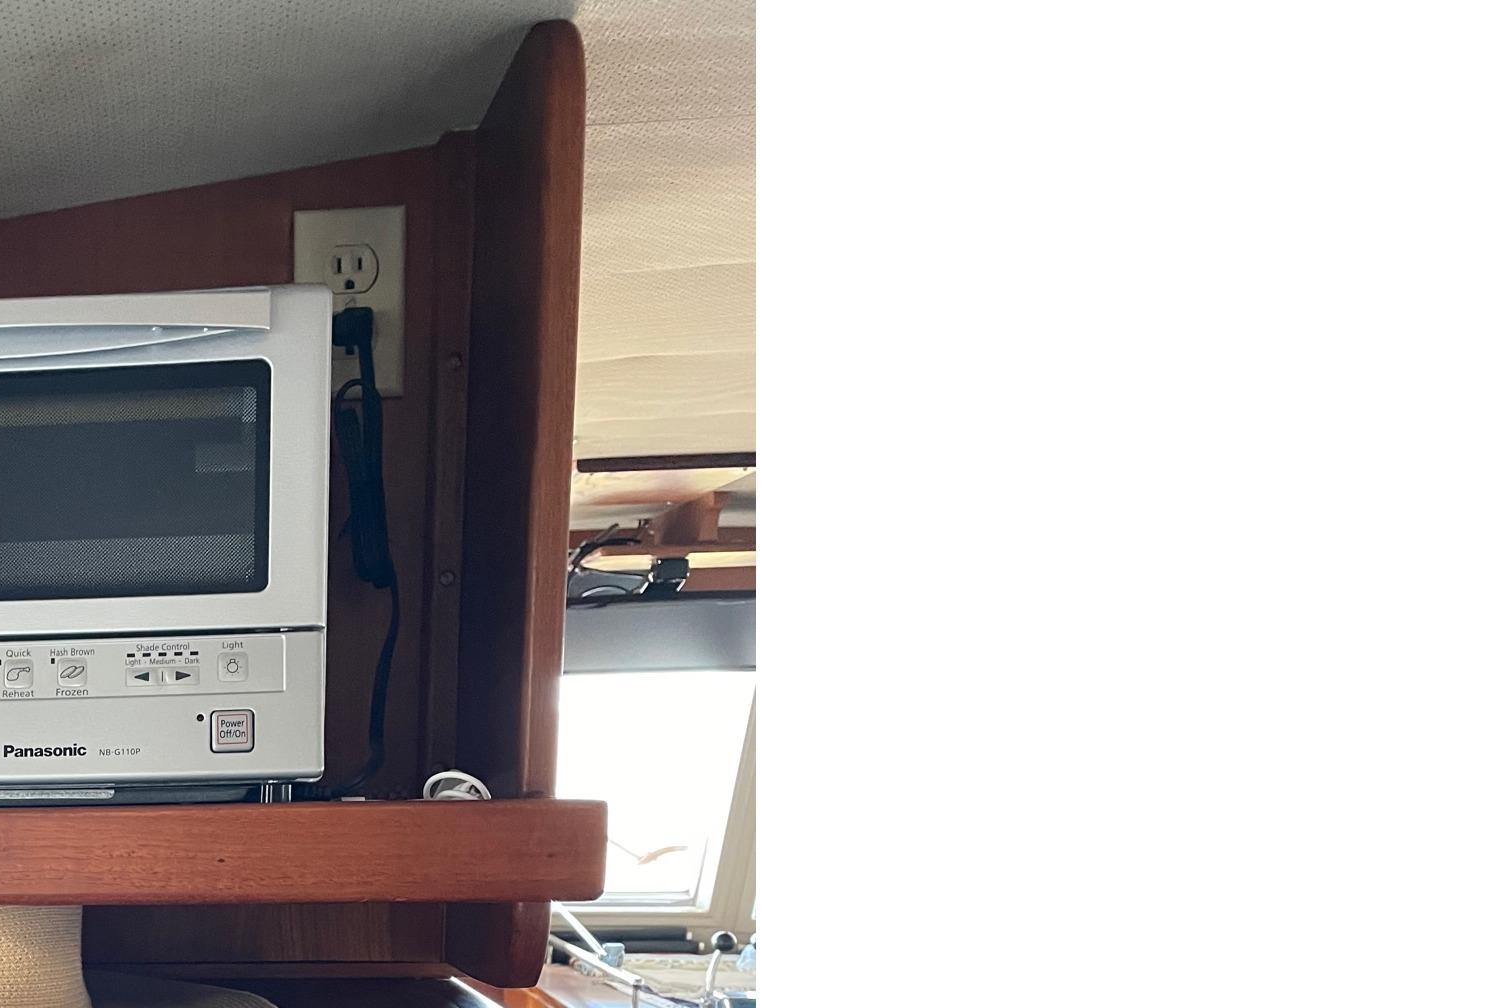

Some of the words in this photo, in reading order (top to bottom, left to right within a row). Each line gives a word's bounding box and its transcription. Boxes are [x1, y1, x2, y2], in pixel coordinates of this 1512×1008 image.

[136, 644, 159, 652] Shade
[161, 642, 190, 651] Control
[222, 641, 243, 650] Light
[5, 649, 31, 658] Quick
[49, 648, 68, 656] Hash
[71, 648, 95, 656] Brown
[125, 658, 141, 666] Light
[149, 657, 176, 665] Medium
[2, 689, 34, 698] Reheat
[55, 688, 88, 696] Frozen
[220, 719, 244, 728] Power
[219, 729, 246, 738] Off/On
[3, 743, 87, 757] Panasonic
[99, 748, 141, 756] NB-G110P
